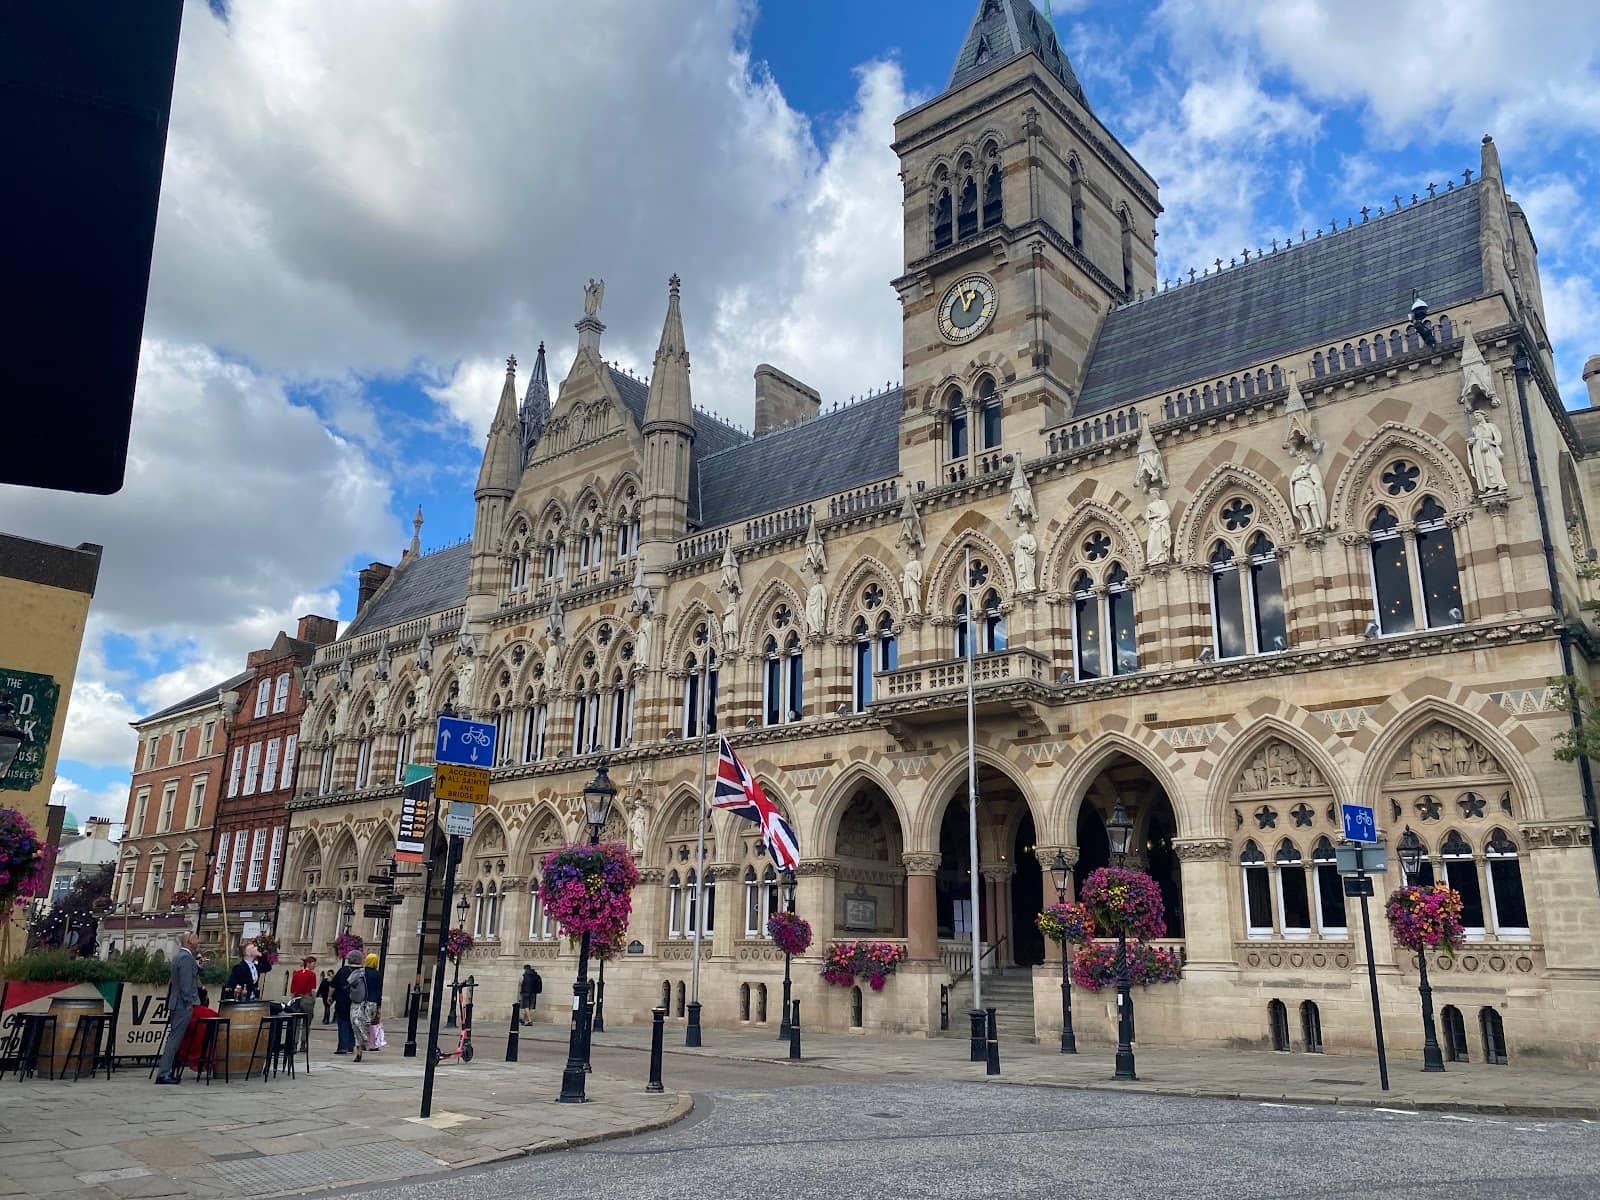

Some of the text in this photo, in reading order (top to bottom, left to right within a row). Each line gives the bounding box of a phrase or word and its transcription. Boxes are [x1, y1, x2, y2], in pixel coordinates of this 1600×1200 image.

[7, 677, 23, 689] THE
[448, 768, 477, 778] ACCESS
[461, 777, 487, 786] SAINTS
[459, 784, 474, 792] AND
[447, 791, 473, 799] BRIDGE
[399, 798, 416, 837] ROUTE
[412, 800, 428, 838] SAFER
[127, 1030, 162, 1044] SHOP
